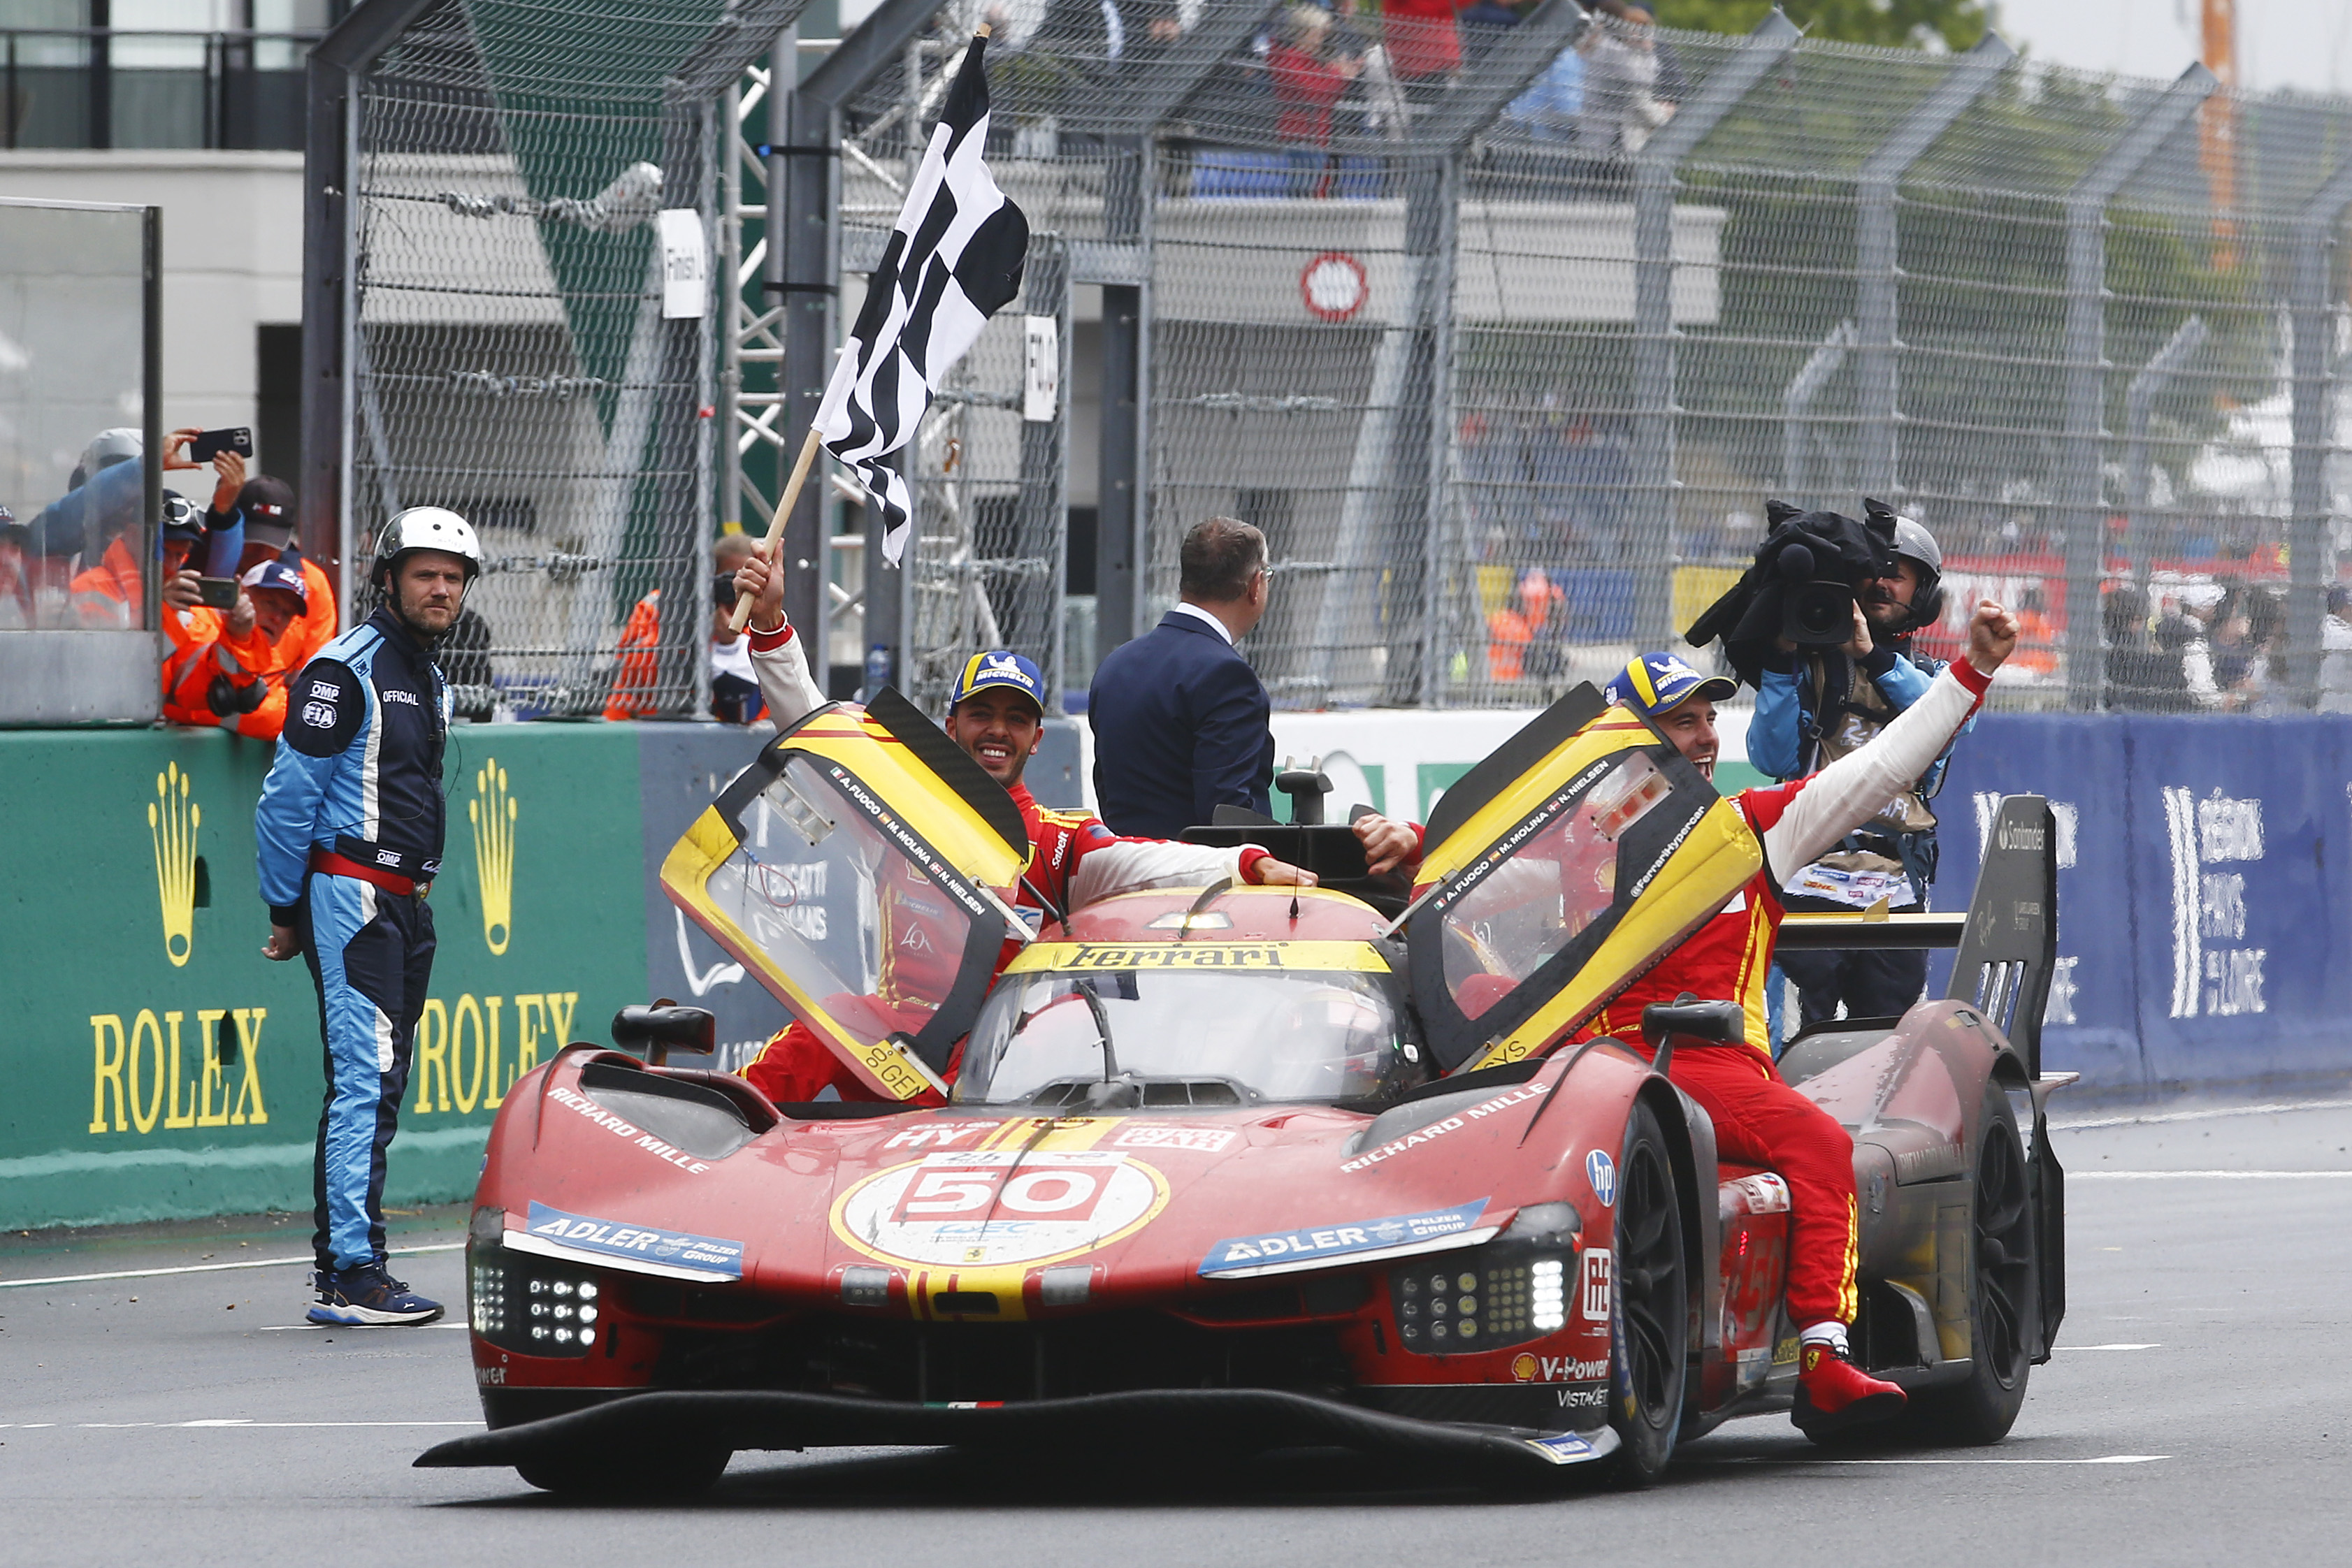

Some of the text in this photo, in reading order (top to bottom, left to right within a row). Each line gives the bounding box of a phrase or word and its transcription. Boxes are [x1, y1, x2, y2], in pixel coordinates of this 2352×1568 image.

[311, 684, 340, 699] OMP
[382, 690, 419, 706] OFFICIAL
[976, 670, 1035, 688] MICHELIN
[1454, 860, 1490, 894] FUOCO
[1509, 811, 1550, 846] MOLINA
[1568, 759, 1610, 797] NIELSEN
[376, 852, 401, 865] OMP
[848, 784, 881, 816] FUOCO
[895, 829, 932, 866] MOLINA
[946, 878, 986, 916] NIELSEN
[1051, 830, 1069, 871] Sabelt
[1067, 945, 1285, 967] Ferrari
[89, 1008, 268, 1134] ROLEX
[547, 1087, 710, 1175] RICHARD MILLE
[1340, 1082, 1551, 1173] RICHARD MILLE
[907, 1171, 1096, 1213] 50
[533, 1218, 740, 1256] ADLER PELZER
[1225, 1214, 1462, 1261] ADLER PELZER
[1413, 1222, 1466, 1236] GROUP
[682, 1251, 728, 1264] GROUP
[1541, 1356, 1608, 1381] V-Power
